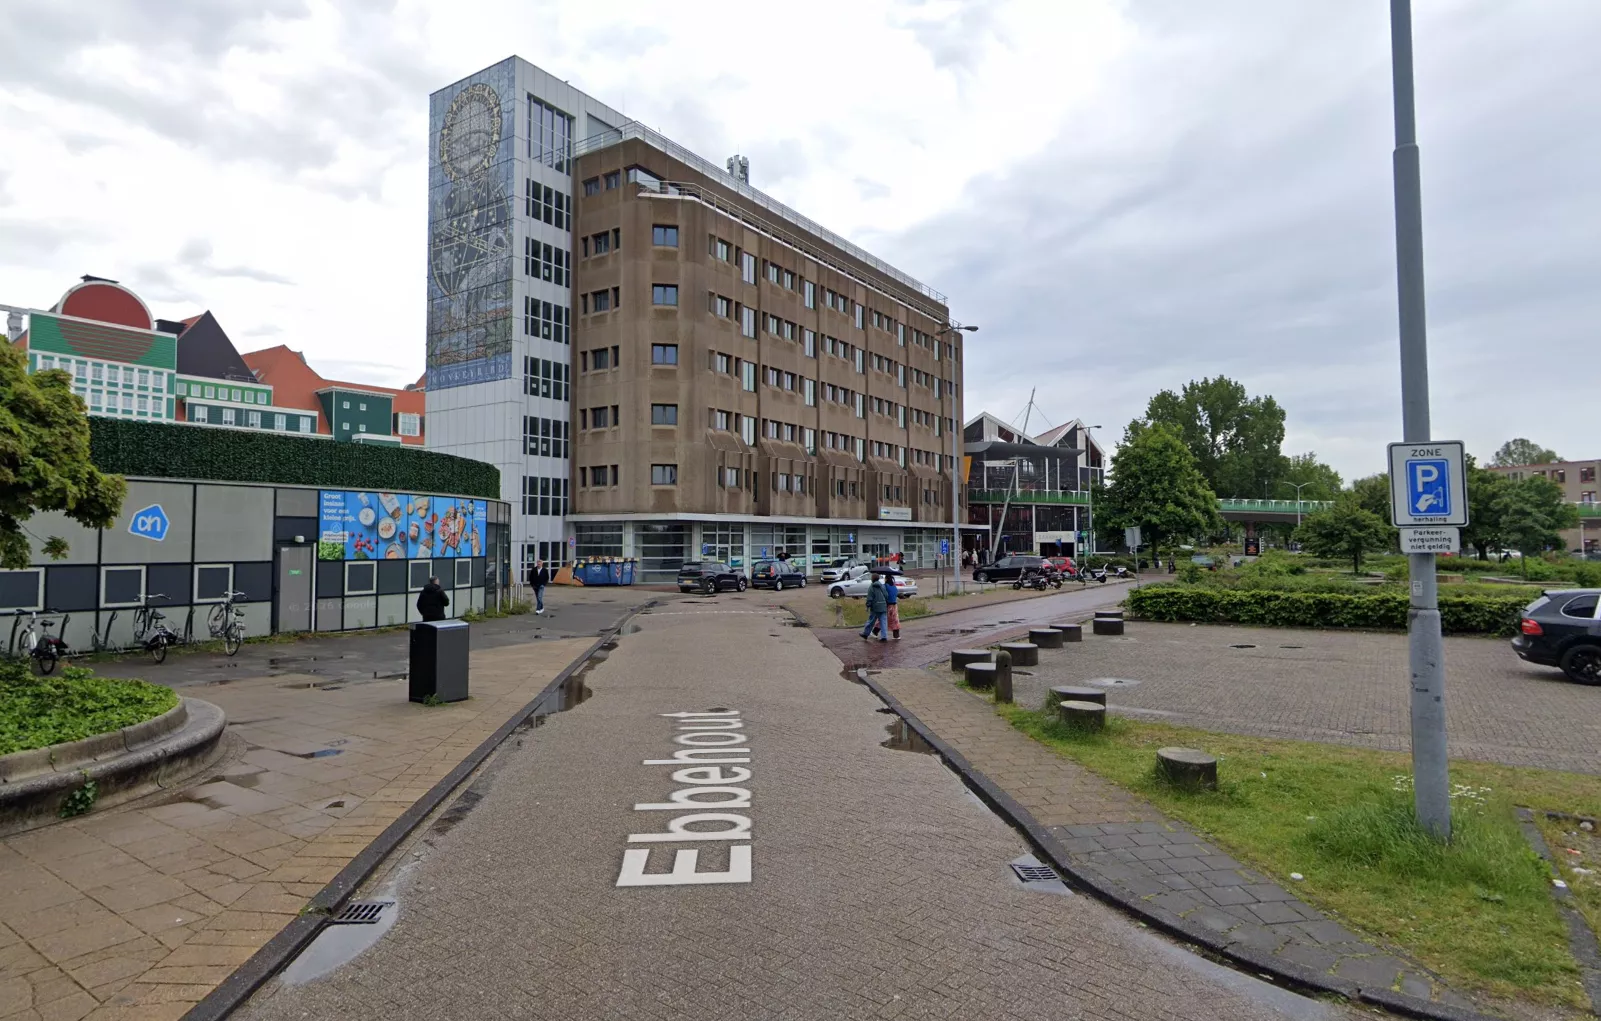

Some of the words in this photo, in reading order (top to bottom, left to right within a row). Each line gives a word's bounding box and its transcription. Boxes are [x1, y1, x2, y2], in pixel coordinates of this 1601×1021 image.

[1411, 448, 1442, 457] ZONE
[1416, 465, 1439, 493] P
[616, 711, 752, 887] Ebbehout
